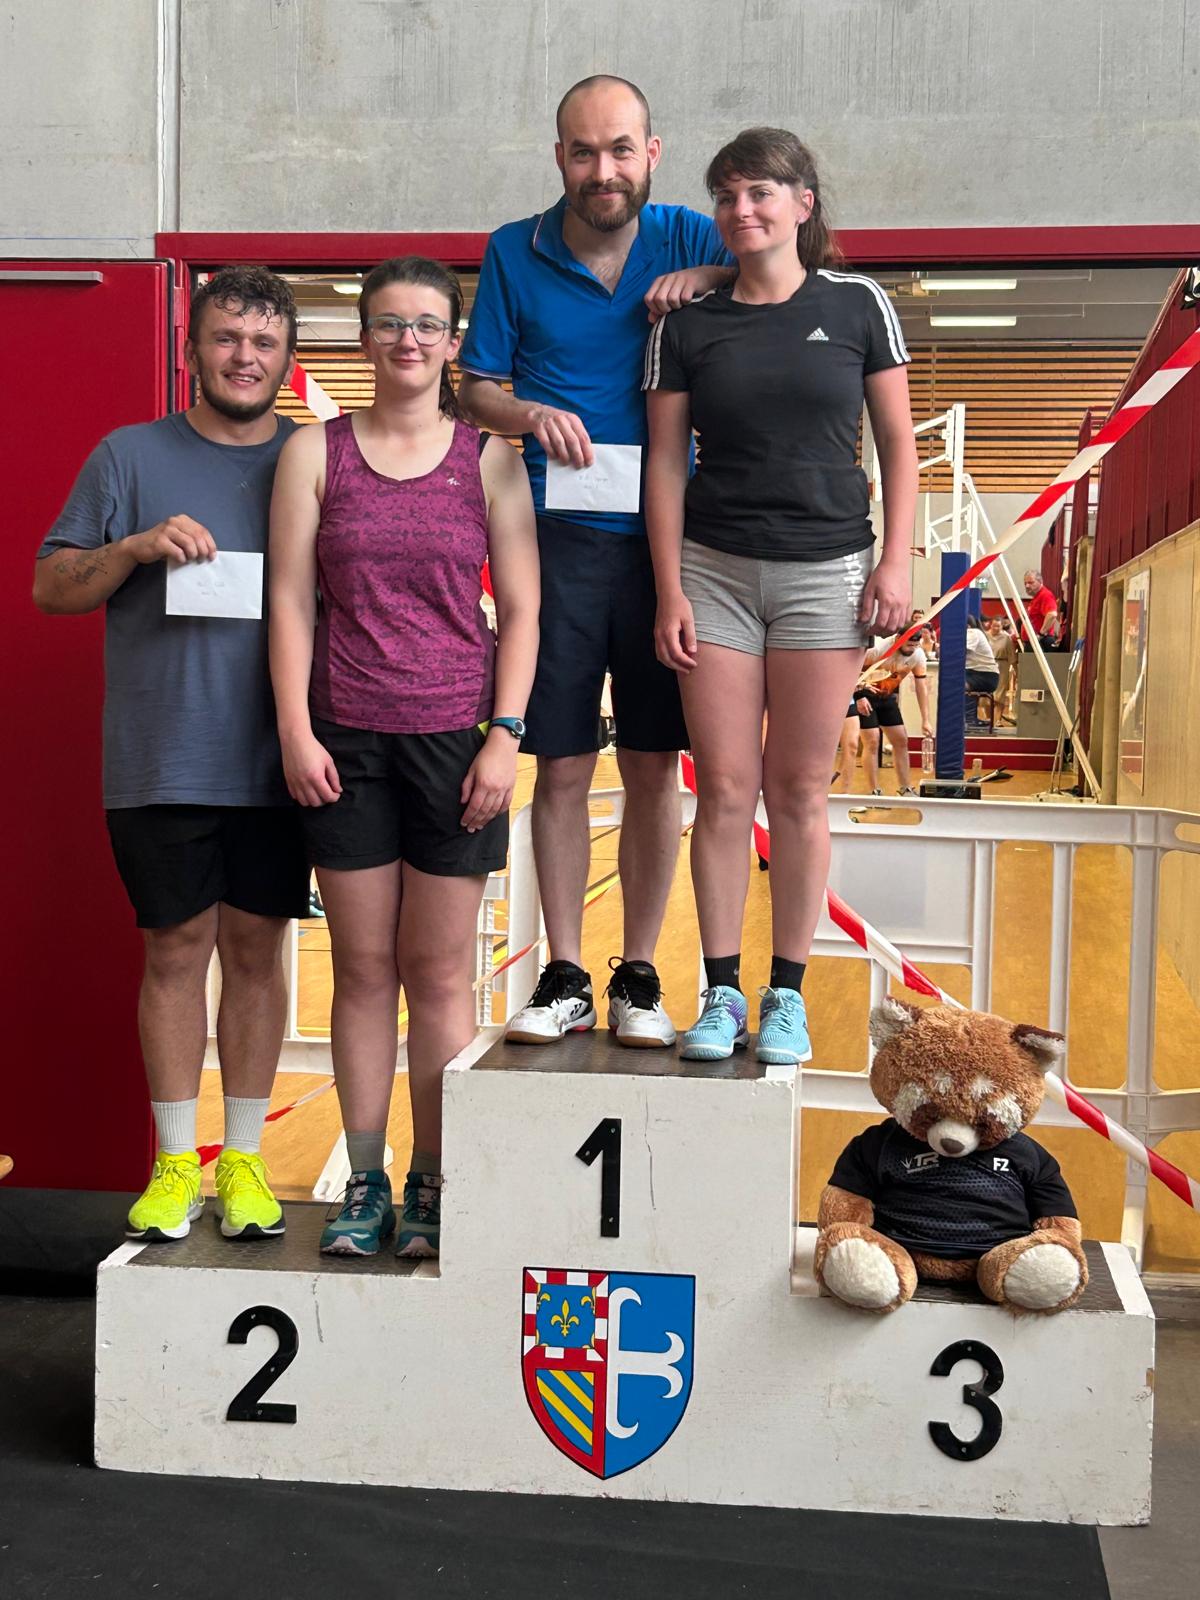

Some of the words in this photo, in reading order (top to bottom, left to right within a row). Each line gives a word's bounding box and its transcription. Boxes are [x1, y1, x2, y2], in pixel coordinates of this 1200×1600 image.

[576, 1118, 621, 1238] 1
[993, 1157, 1009, 1172] FZ
[226, 1306, 298, 1424] 2
[929, 1340, 1004, 1462] 3
